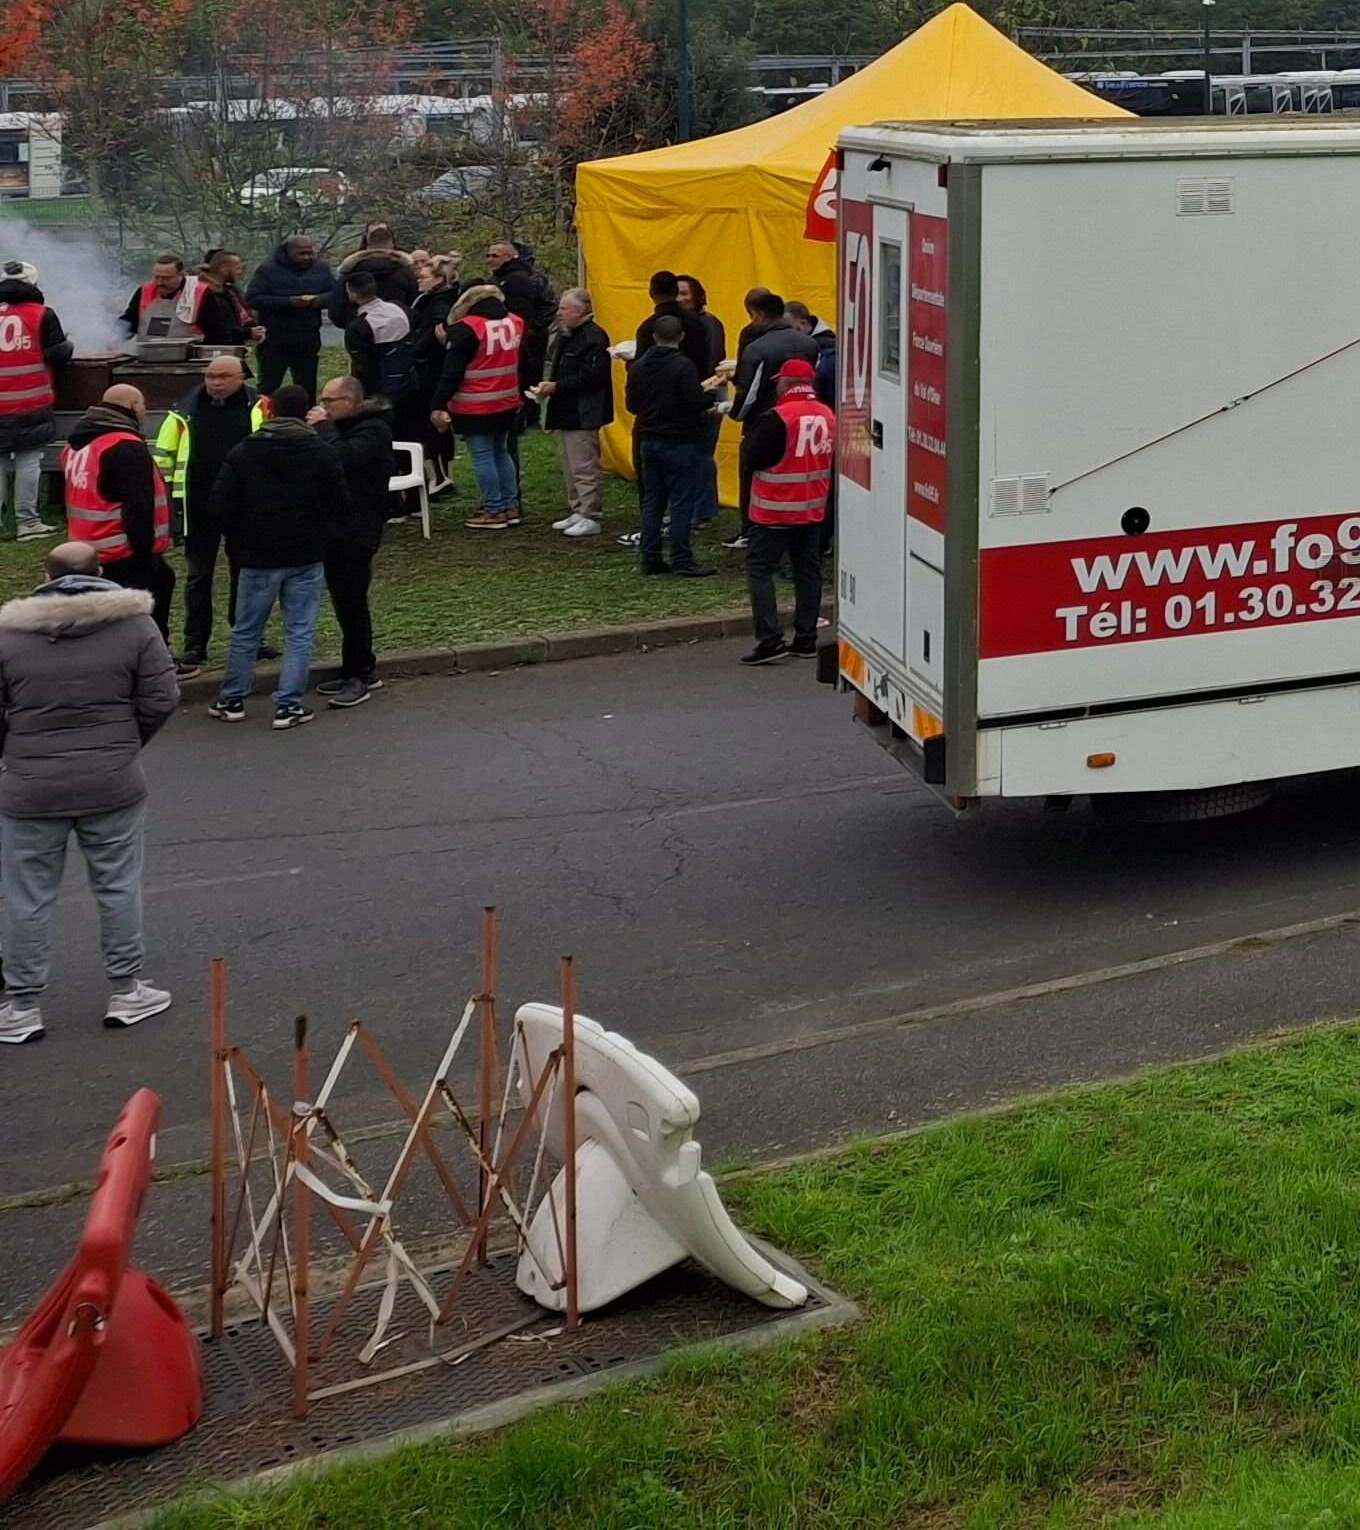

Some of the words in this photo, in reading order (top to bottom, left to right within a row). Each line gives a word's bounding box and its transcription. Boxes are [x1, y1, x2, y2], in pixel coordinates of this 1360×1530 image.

[0, 315, 23, 352] O
[15, 335, 32, 351] 95
[841, 230, 871, 410] FO
[795, 415, 829, 458] FO
[1056, 601, 1147, 641] Tél:
